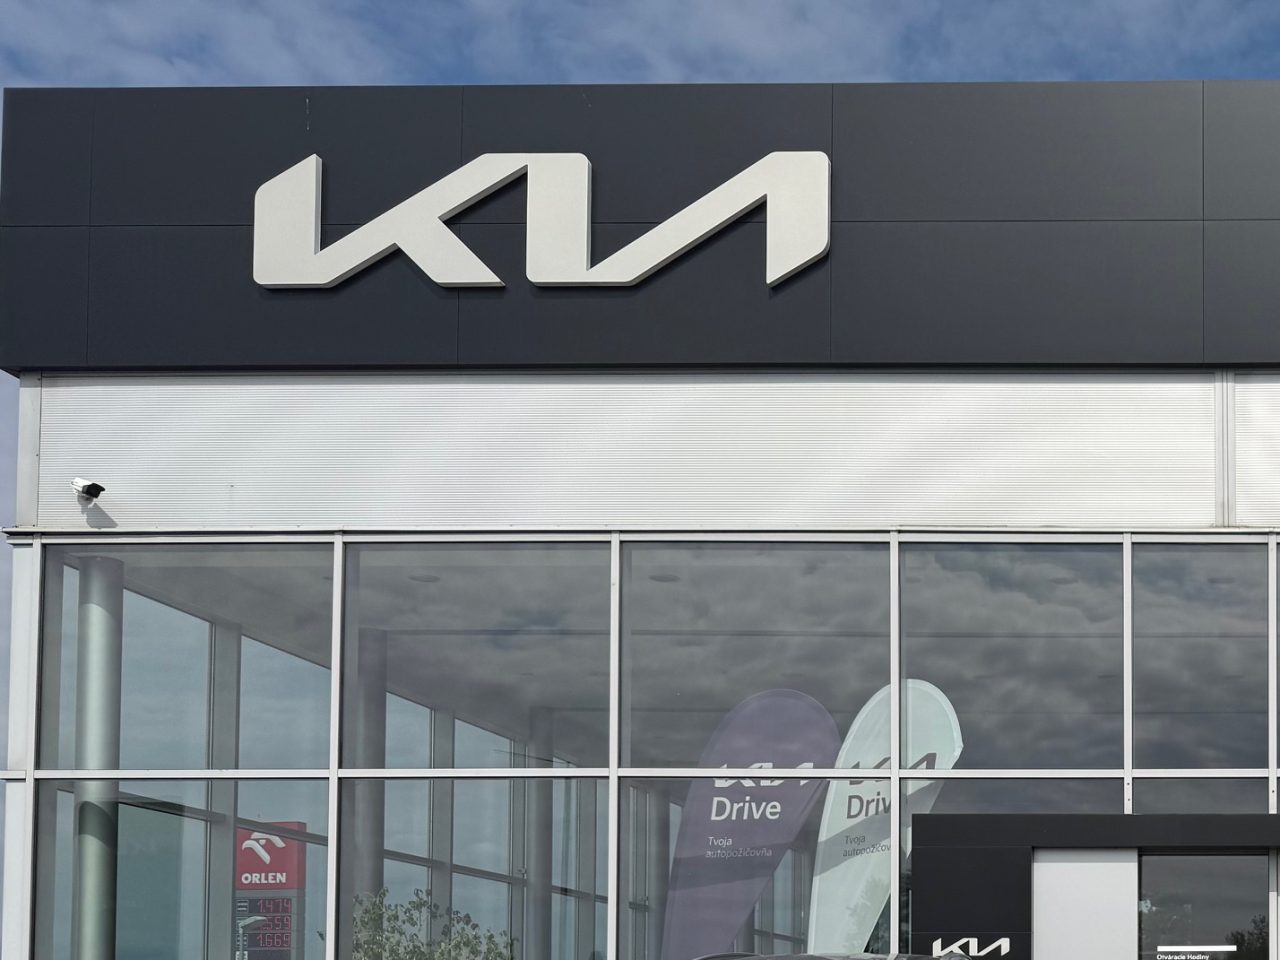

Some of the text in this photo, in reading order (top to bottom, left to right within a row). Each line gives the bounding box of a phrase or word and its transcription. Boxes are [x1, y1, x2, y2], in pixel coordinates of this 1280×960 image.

[252, 149, 832, 289] KIA
[710, 795, 782, 821] Drive
[846, 791, 892, 820] Driv
[707, 836, 733, 847] Tvoja
[844, 834, 866, 846] Tvoja
[842, 842, 892, 859] autopožičov
[241, 872, 287, 884] ORLEN
[932, 937, 1011, 958] KIA
